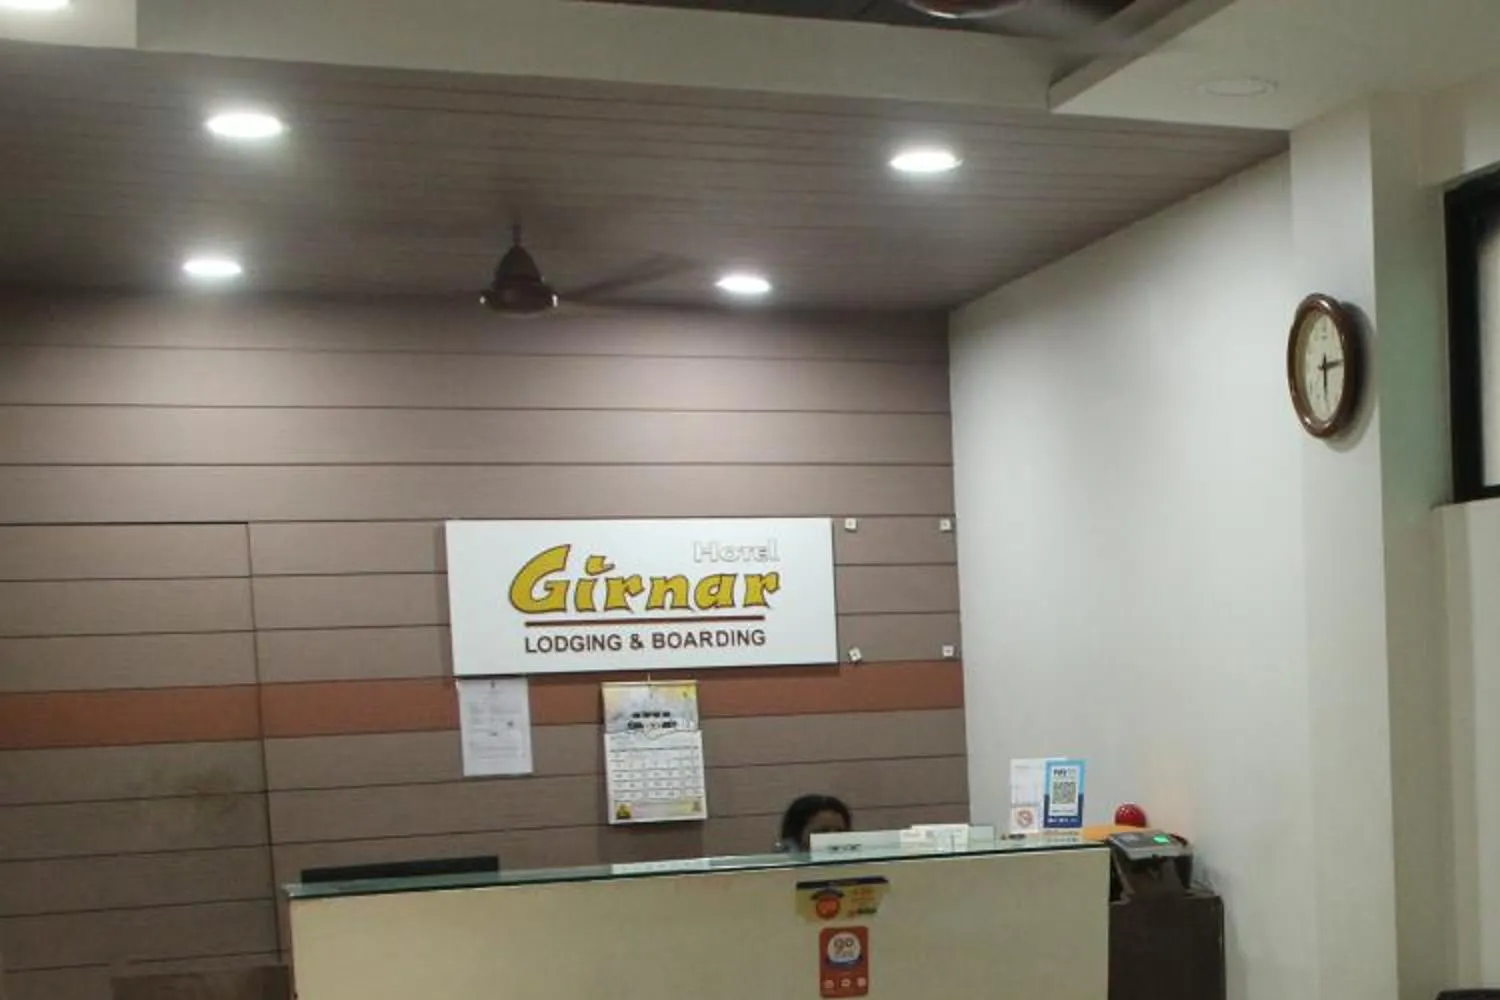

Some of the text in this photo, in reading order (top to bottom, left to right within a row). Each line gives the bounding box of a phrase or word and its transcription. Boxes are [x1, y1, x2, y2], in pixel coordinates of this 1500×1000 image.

[510, 544, 780, 614] Girnar
[525, 630, 766, 653] LODGING & BOARDING
